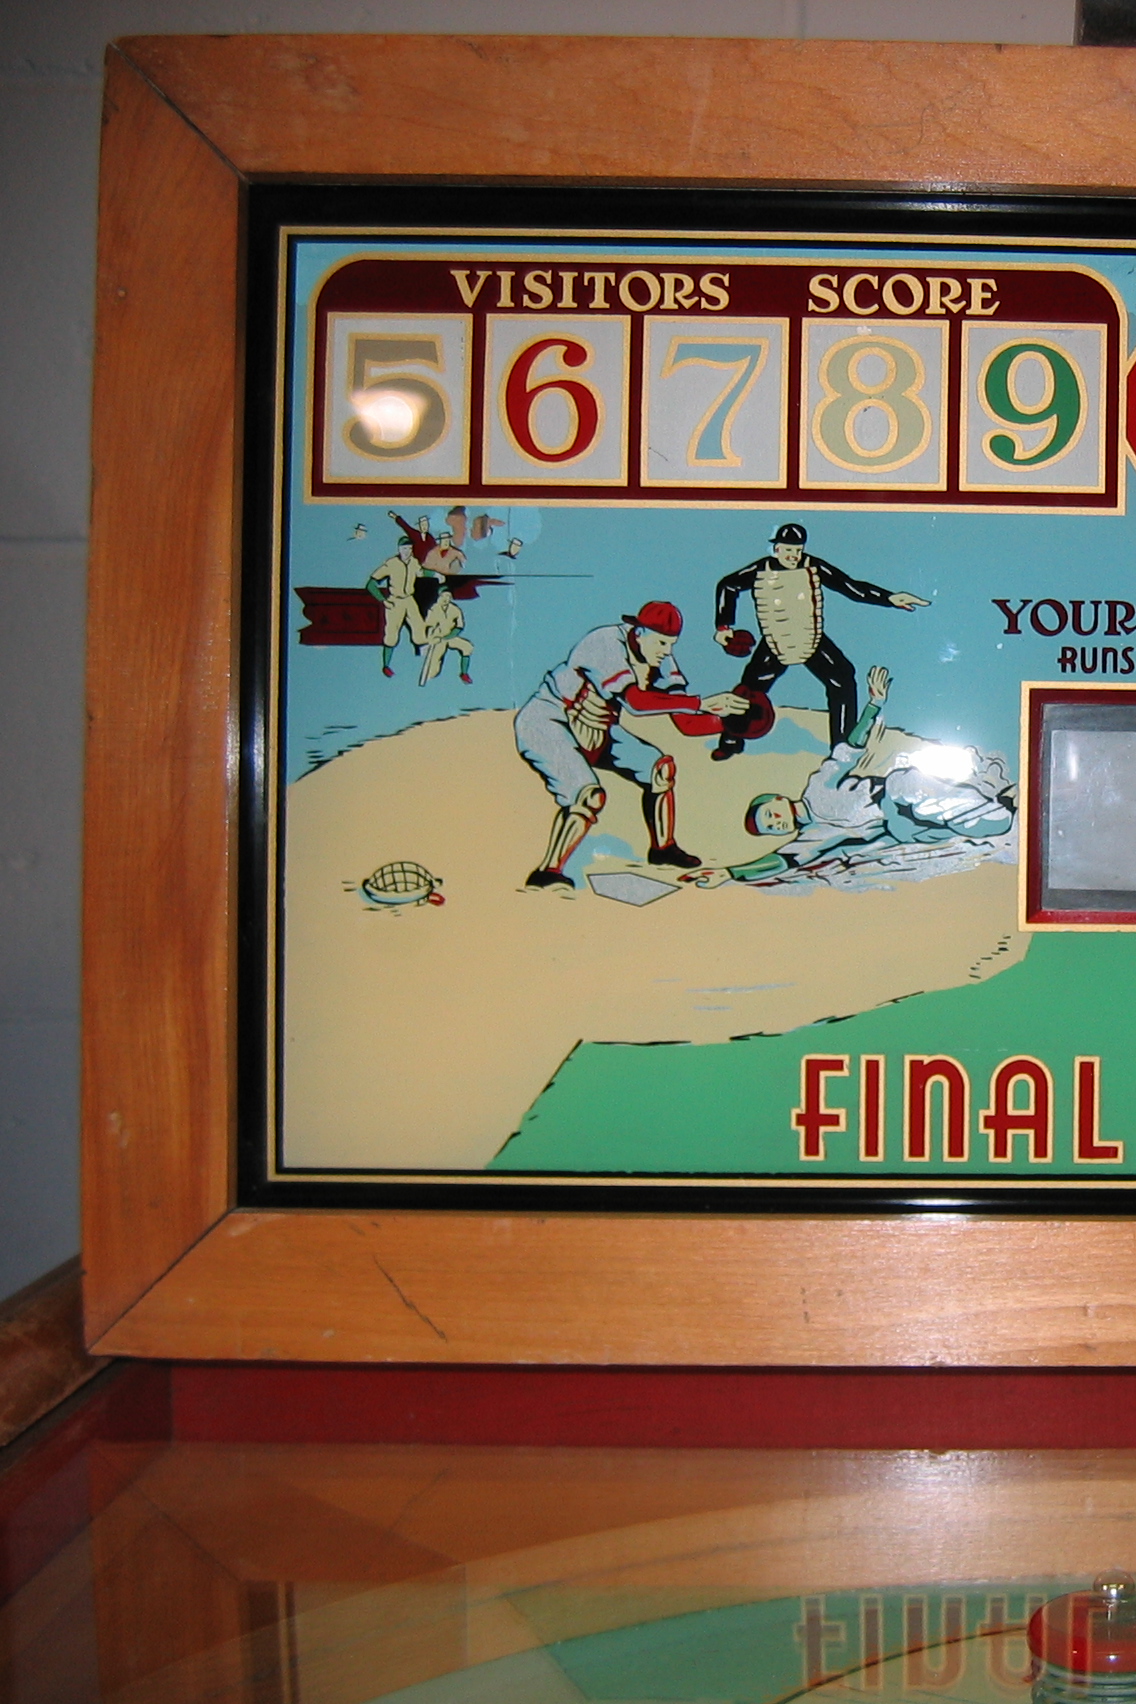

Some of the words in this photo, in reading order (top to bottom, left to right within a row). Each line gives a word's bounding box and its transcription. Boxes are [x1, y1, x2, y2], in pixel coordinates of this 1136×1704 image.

[450, 270, 730, 311] VISITORS
[807, 274, 1000, 315] SCORE
[343, 332, 449, 461] 5
[499, 338, 602, 467] 6
[661, 336, 771, 467] 7
[813, 335, 932, 474] 8
[976, 341, 1086, 473] 9
[1057, 646, 1136, 675] RUNS
[791, 1053, 1125, 1164] FINAL
